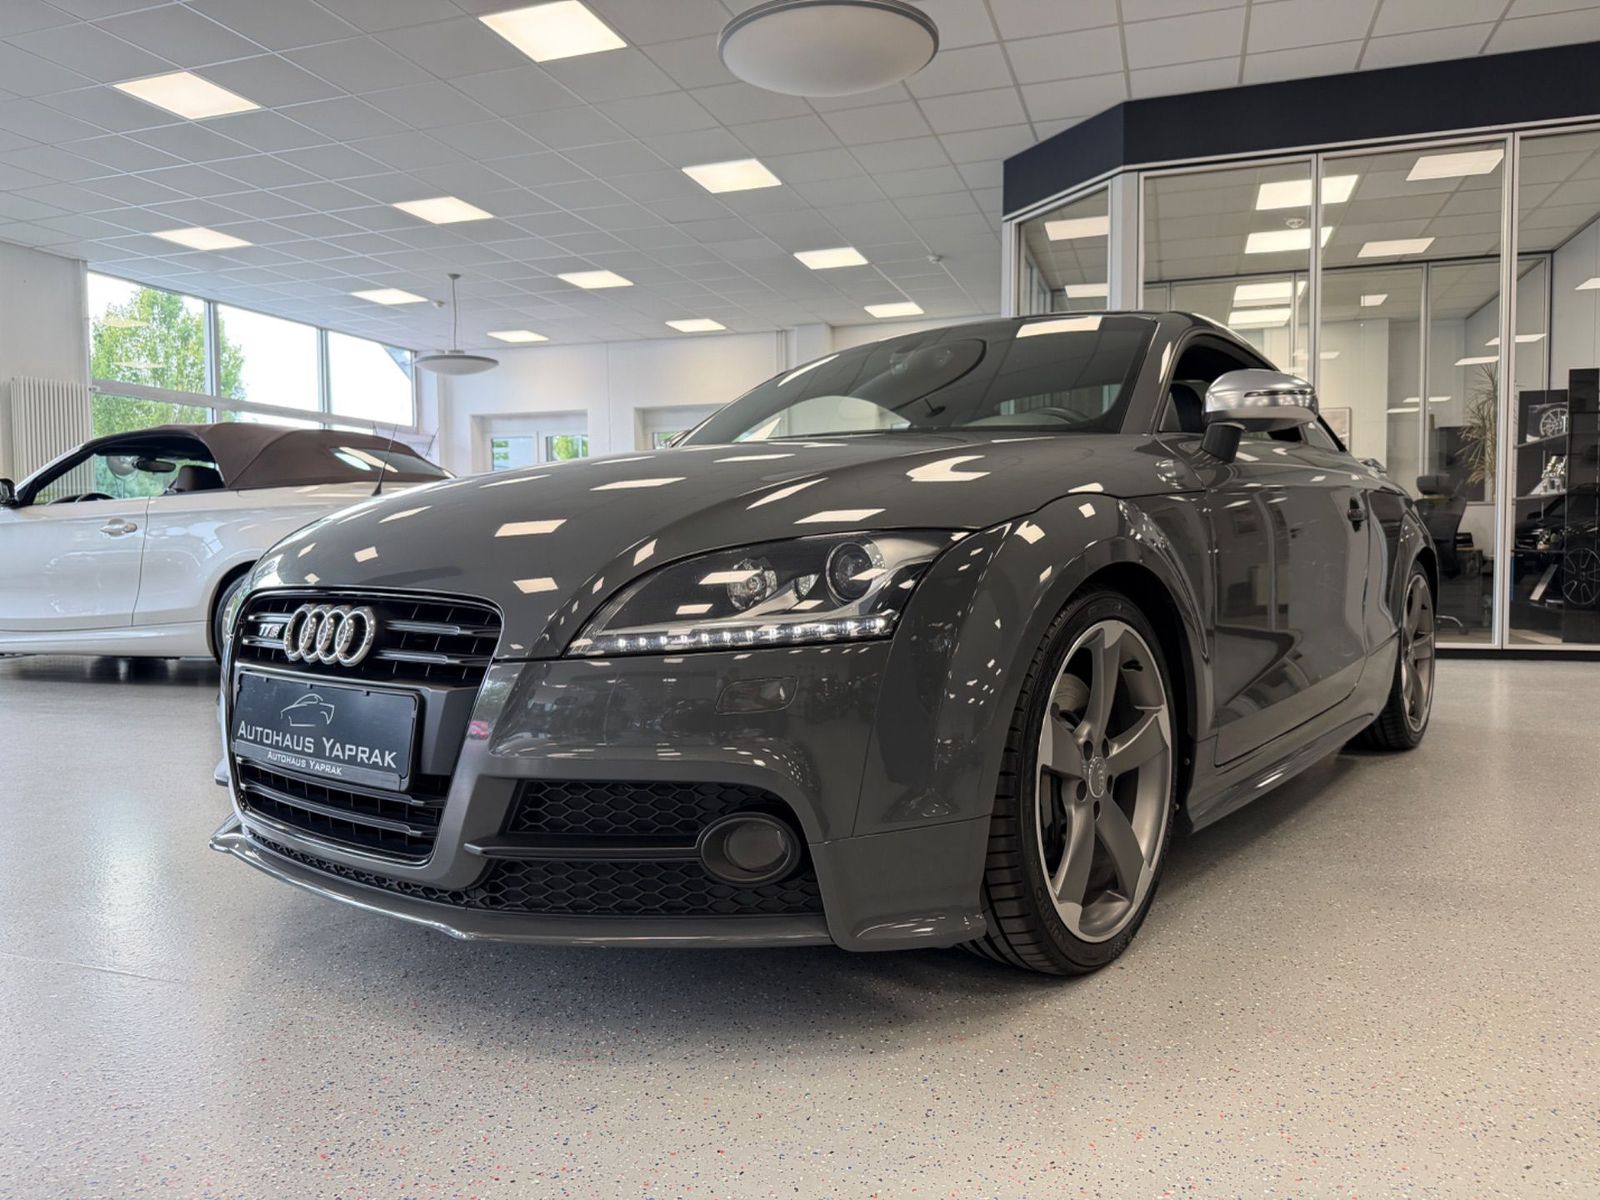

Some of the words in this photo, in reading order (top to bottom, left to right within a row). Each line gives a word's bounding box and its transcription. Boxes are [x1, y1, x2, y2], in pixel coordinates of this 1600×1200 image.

[237, 720, 314, 753] AUTOHAUS
[322, 736, 397, 769] YAPRAK
[267, 751, 306, 768] AUTOHAUS
[309, 760, 342, 776] YAPRAK
